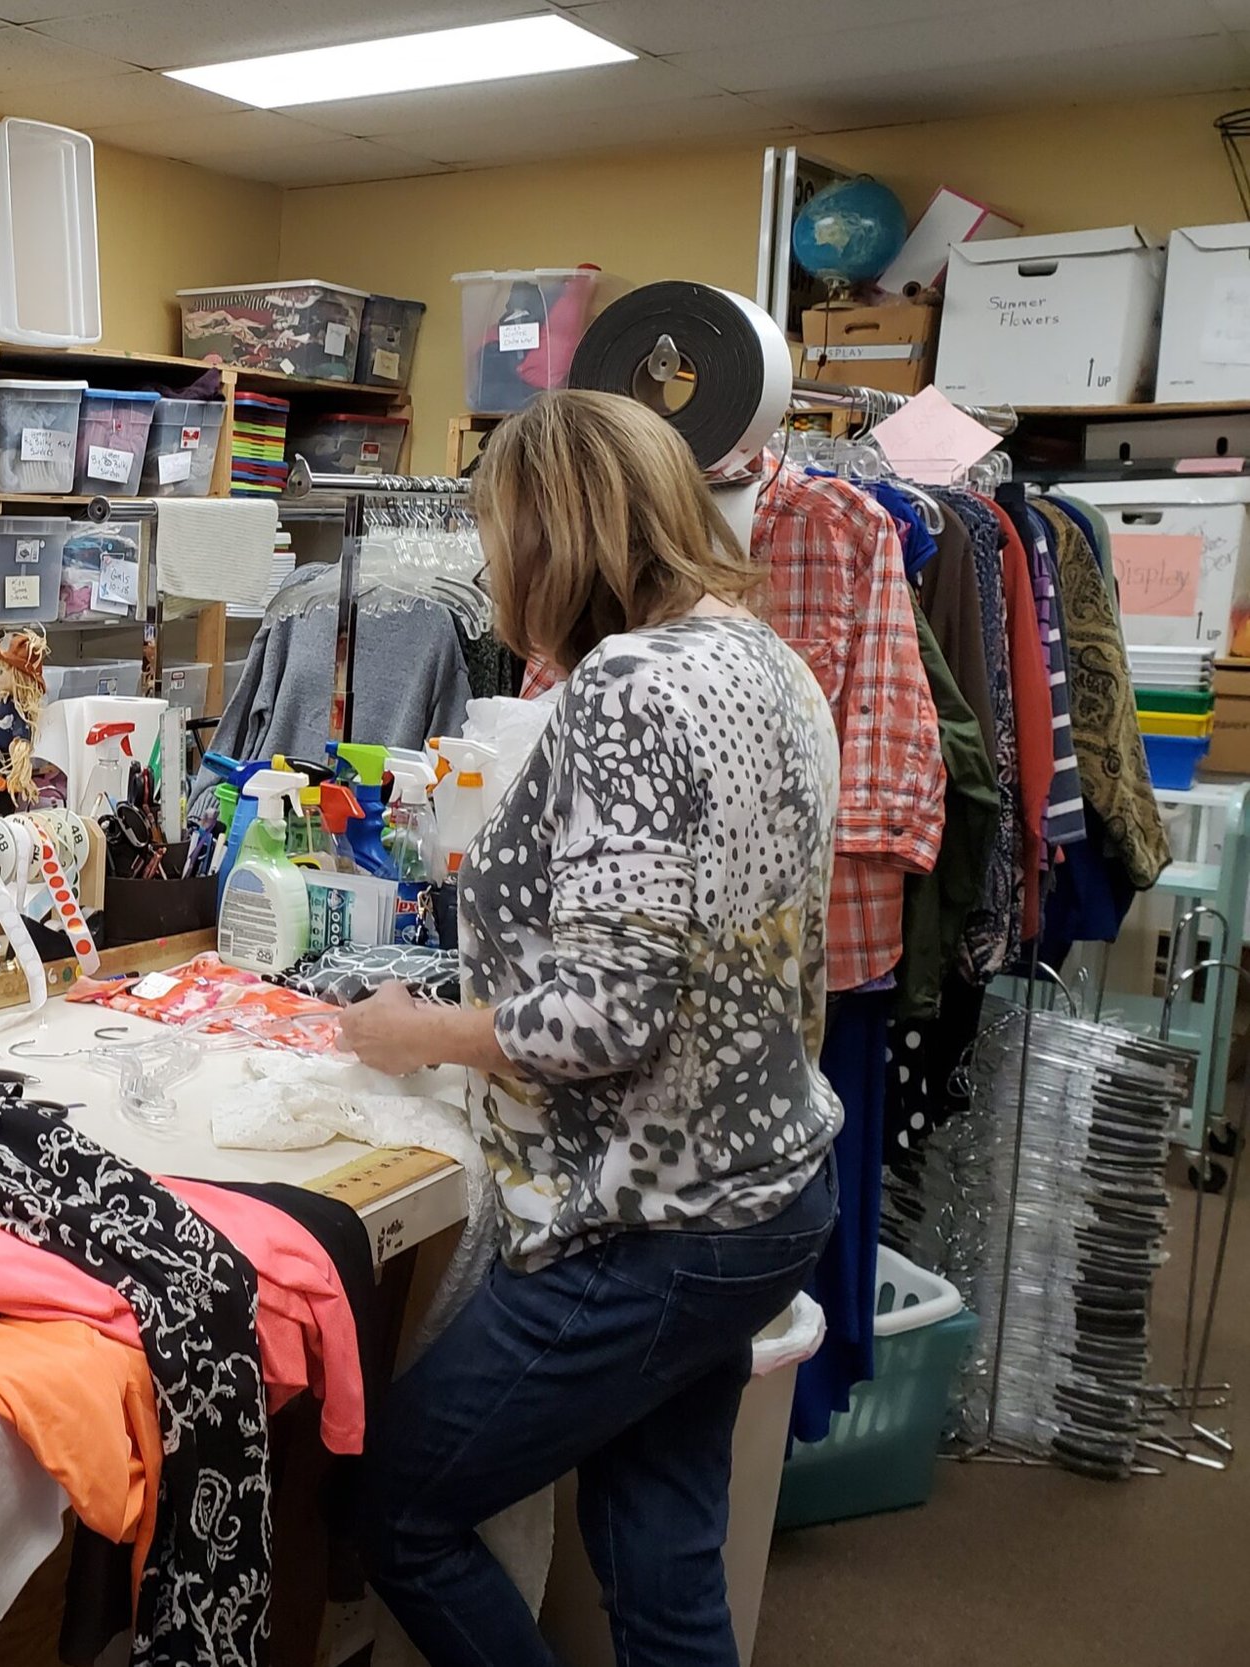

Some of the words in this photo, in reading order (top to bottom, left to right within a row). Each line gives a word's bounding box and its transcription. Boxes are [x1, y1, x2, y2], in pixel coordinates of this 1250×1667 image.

[988, 295, 1047, 310] Summer
[999, 311, 1060, 327] Flowers
[816, 348, 864, 358] DSPLAY
[1097, 375, 1112, 388] UP
[1207, 629, 1222, 641] UP
